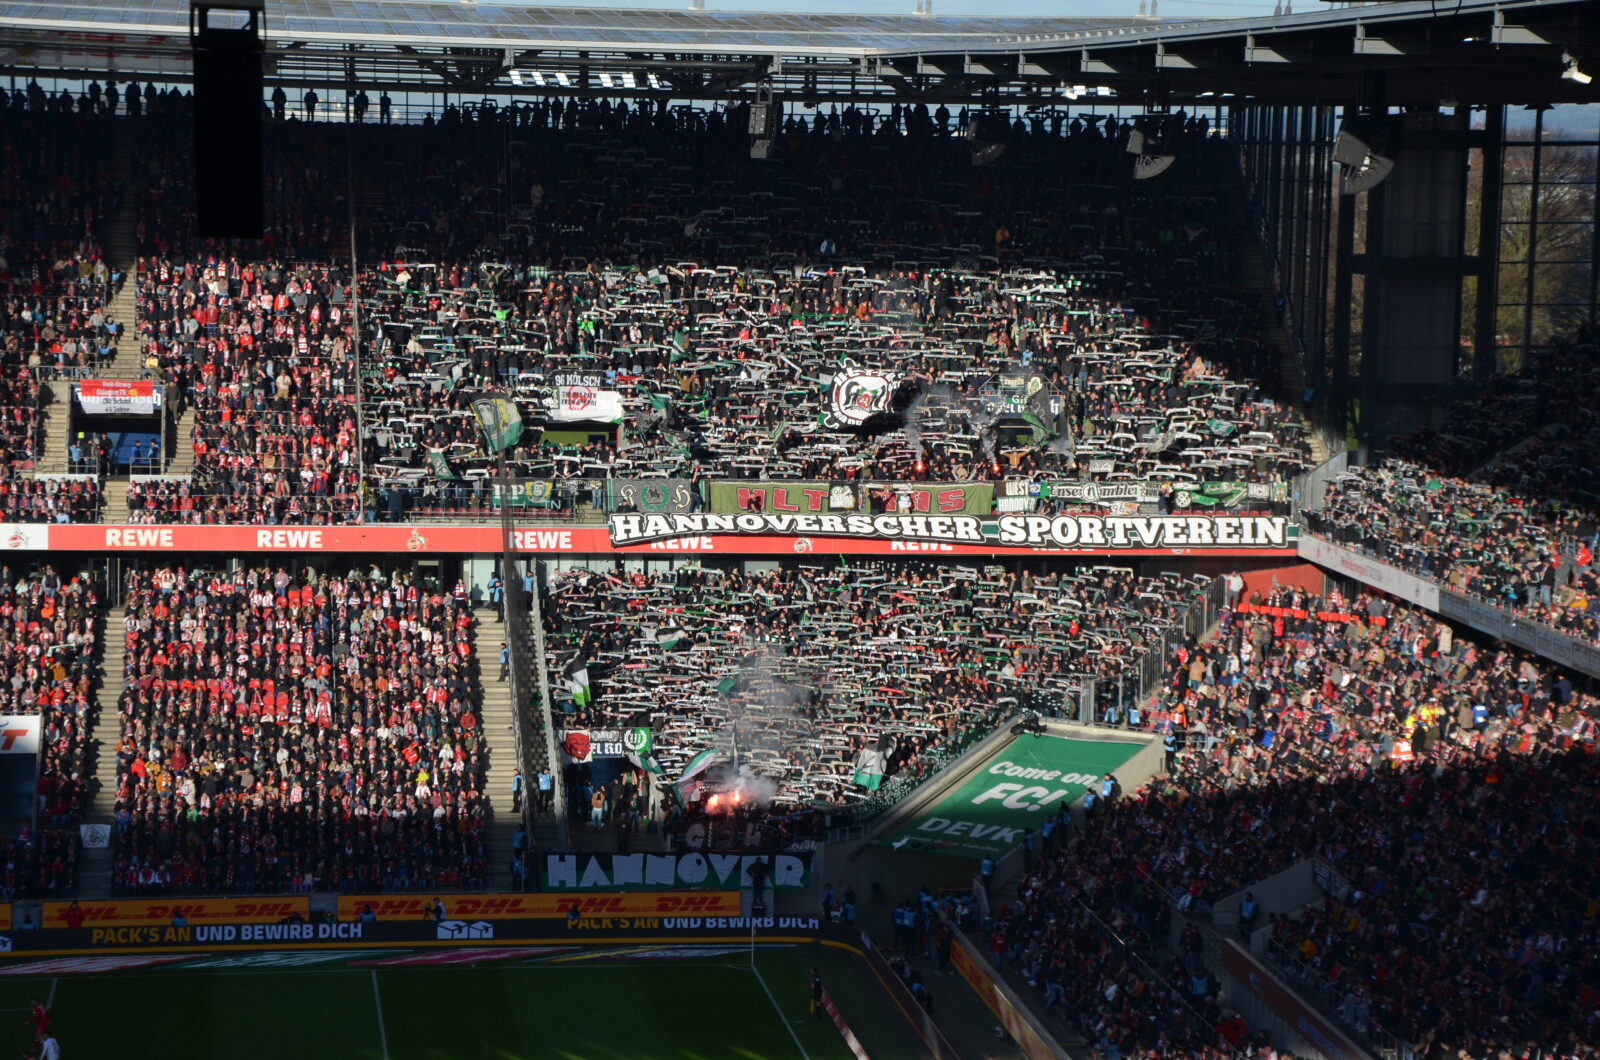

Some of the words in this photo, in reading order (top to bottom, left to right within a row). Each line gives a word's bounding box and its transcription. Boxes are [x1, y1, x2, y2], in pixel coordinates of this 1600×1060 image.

[555, 375, 565, 386] 96
[612, 513, 982, 542] HANNOVERSCHER
[1000, 515, 1286, 545] SPORTVEREIN
[106, 529, 174, 548] REWE
[257, 529, 323, 548] REWE
[509, 530, 572, 549] REWE
[988, 761, 1061, 781] Come
[971, 782, 1069, 812] FC!
[917, 817, 1025, 843] DEVK
[145, 904, 208, 920] DHL
[232, 903, 298, 917] DHL
[353, 900, 424, 916] DHL
[454, 898, 527, 915] DHL
[555, 897, 627, 913] DHL
[655, 896, 726, 912] DHL
[163, 926, 192, 943] AN
[195, 925, 237, 942] UND
[240, 923, 314, 941] BEWIRB
[318, 922, 362, 940] DICH
[634, 917, 660, 929] AN
[663, 917, 703, 929] UND
[705, 917, 775, 929] BEWIRB
[779, 917, 820, 930] DICH
